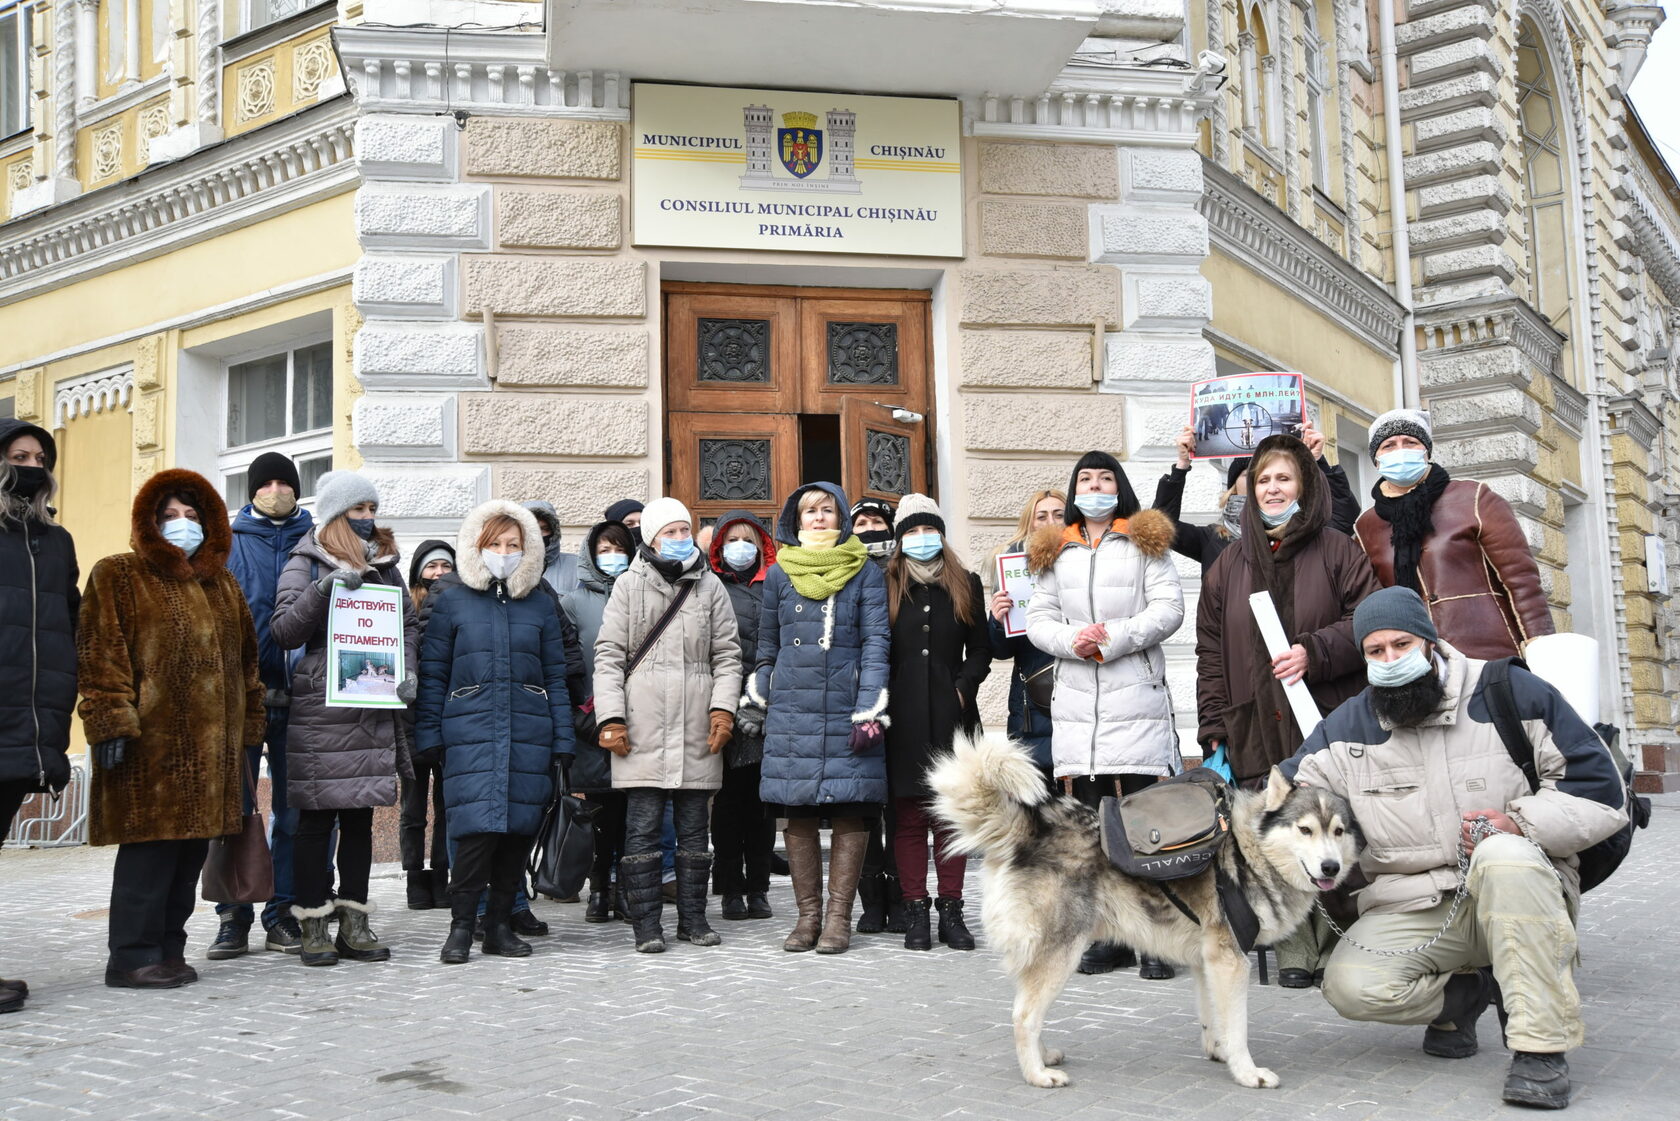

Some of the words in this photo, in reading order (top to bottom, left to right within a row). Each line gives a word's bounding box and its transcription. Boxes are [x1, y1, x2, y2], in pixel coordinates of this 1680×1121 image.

[642, 133, 743, 150] MUNICIPIUL
[870, 144, 946, 161] CHIȘINĂU
[660, 198, 754, 215] CONSILIUL
[757, 203, 854, 219] MUNICIPAL
[856, 206, 938, 224] CHIȘINĂU
[758, 222, 844, 239] PRIMĂRIA
[1194, 395, 1217, 405] КУДА
[1219, 392, 1242, 401] ИДУТ
[335, 597, 397, 613] ДЕЙСТВУЙТЕ
[357, 617, 373, 628] ПО
[333, 633, 398, 647] РЕГЛАМЕНТУ!
